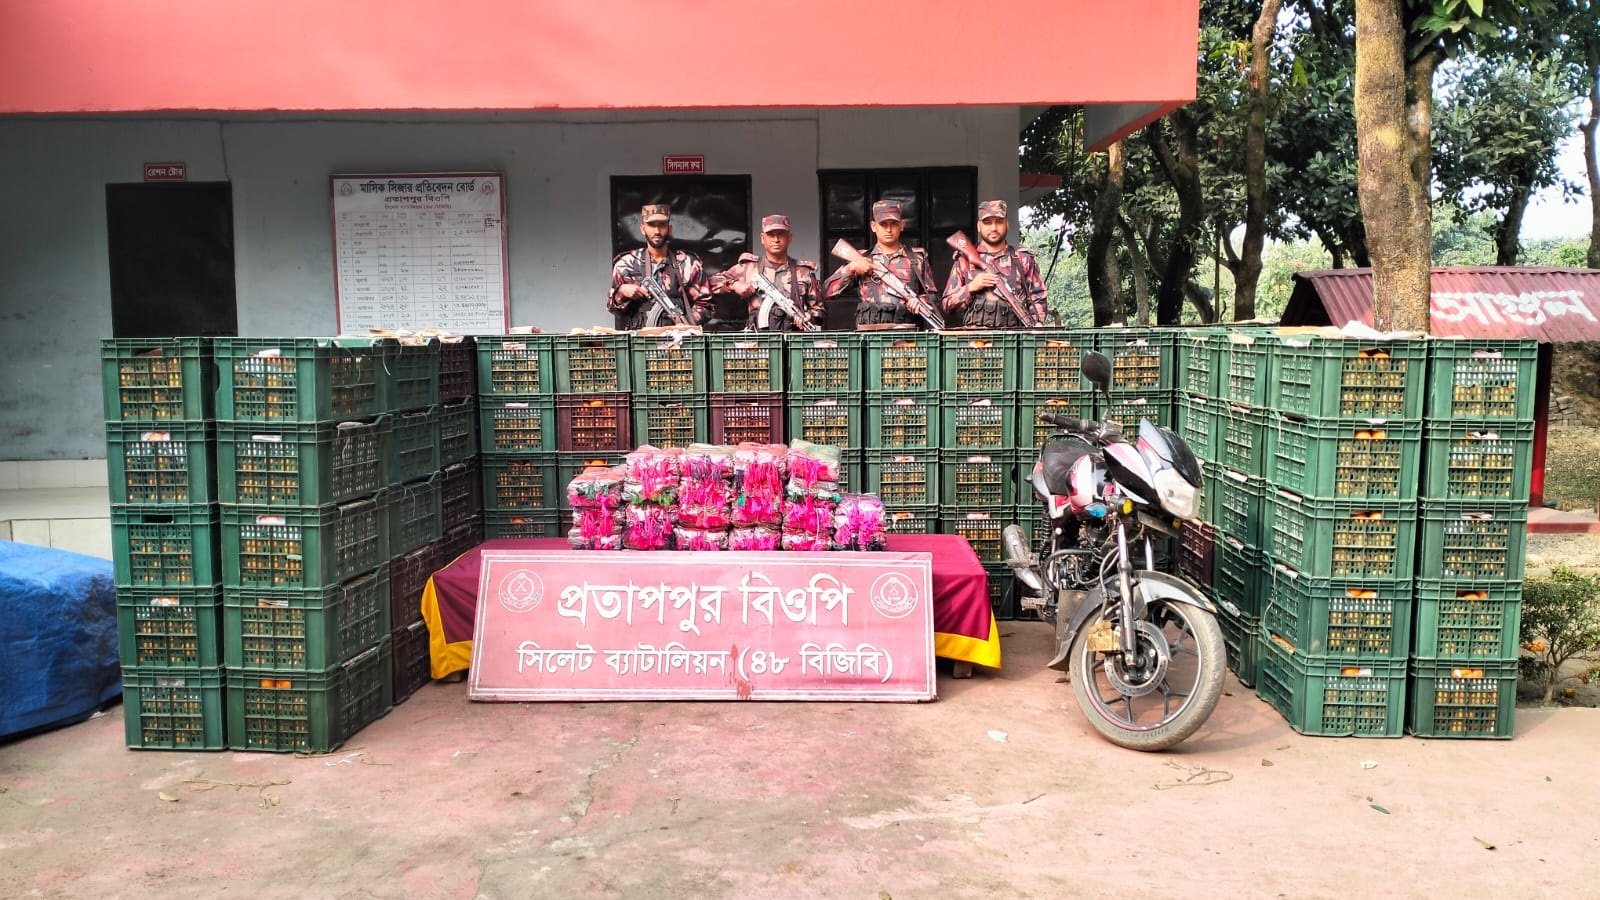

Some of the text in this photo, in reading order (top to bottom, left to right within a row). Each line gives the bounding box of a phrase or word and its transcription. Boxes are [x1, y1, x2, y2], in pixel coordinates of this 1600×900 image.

[360, 179, 475, 194] মাসিক সিজার প্রতিবেদন বোর্ড
[557, 573, 855, 635] প্রতাপপুর বিওপি
[516, 641, 894, 684] সিলেট ব্যাটালিয়ন (৪৮ বিজিবি)
